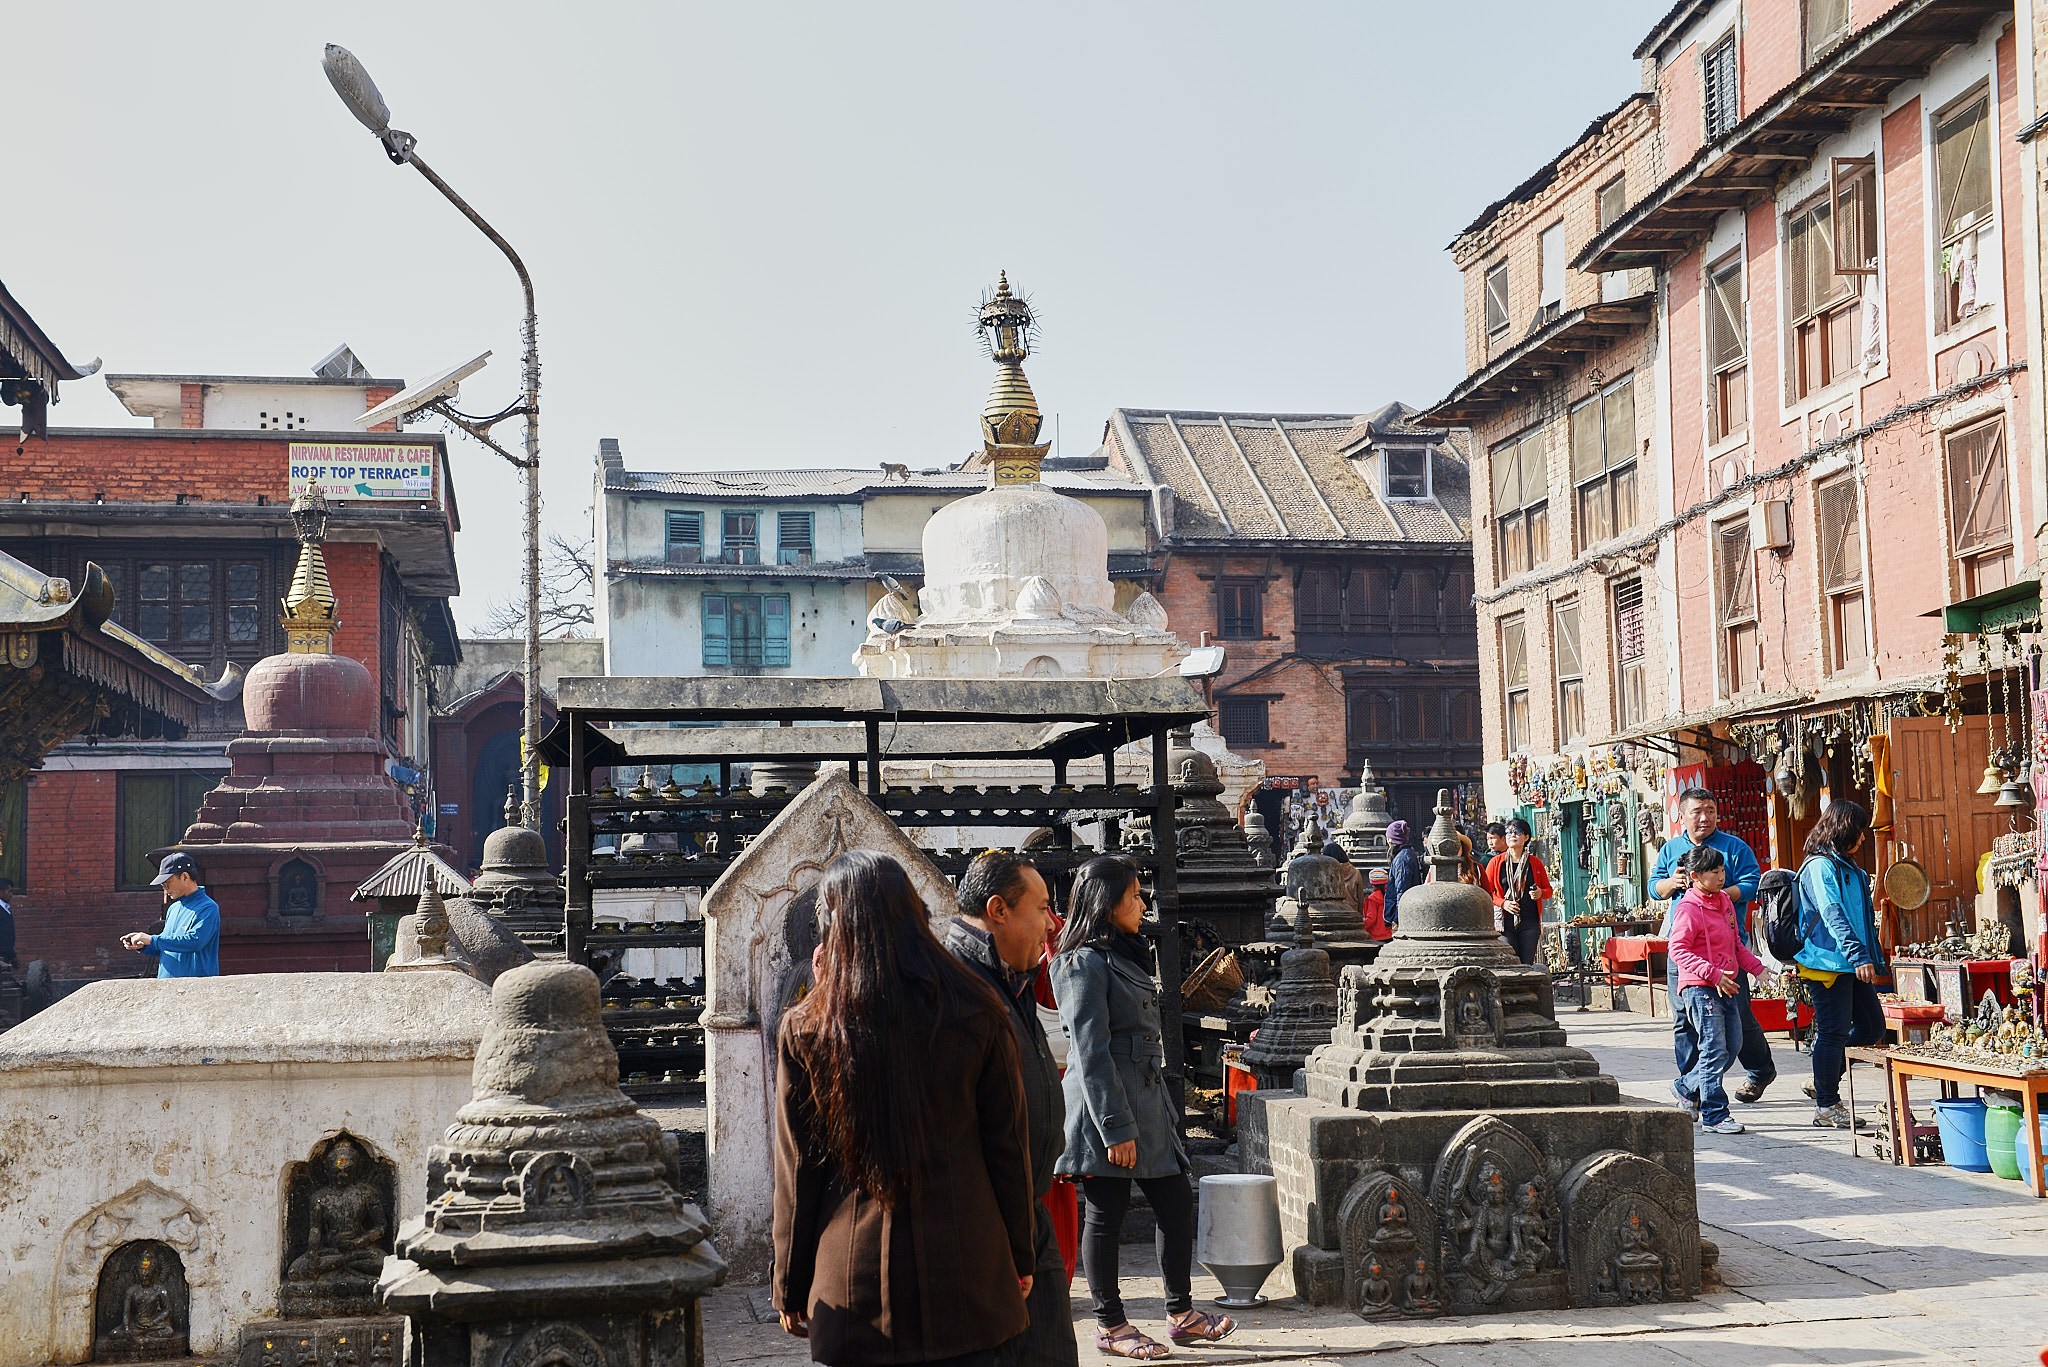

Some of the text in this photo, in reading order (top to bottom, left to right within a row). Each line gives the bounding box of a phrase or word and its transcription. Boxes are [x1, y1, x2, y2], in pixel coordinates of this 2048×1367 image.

[291, 446, 430, 463] NIRVANA RESTAURANT & CAFE
[291, 466, 326, 479] ROOF
[330, 466, 356, 479] TOP
[330, 485, 350, 495] VIEW
